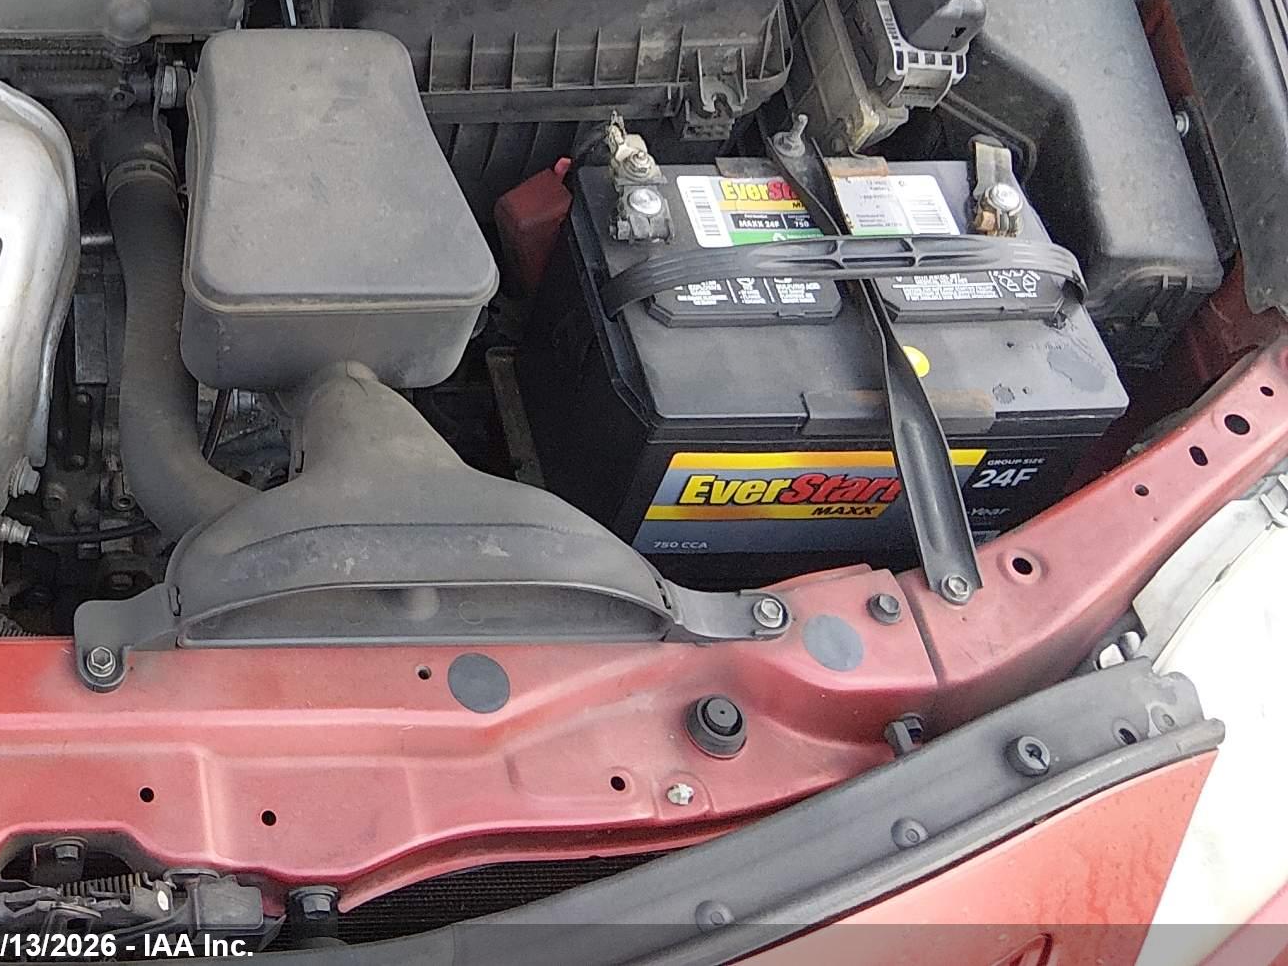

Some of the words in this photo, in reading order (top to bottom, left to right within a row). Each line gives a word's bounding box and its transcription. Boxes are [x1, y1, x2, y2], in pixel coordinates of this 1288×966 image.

[719, 179, 798, 201] EverSt
[793, 220, 810, 228] 750
[987, 458, 1022, 466] GROUP
[972, 467, 1038, 488] 24F
[811, 506, 877, 516] MAXX
[652, 541, 679, 549] 750
[681, 541, 708, 549] CCA
